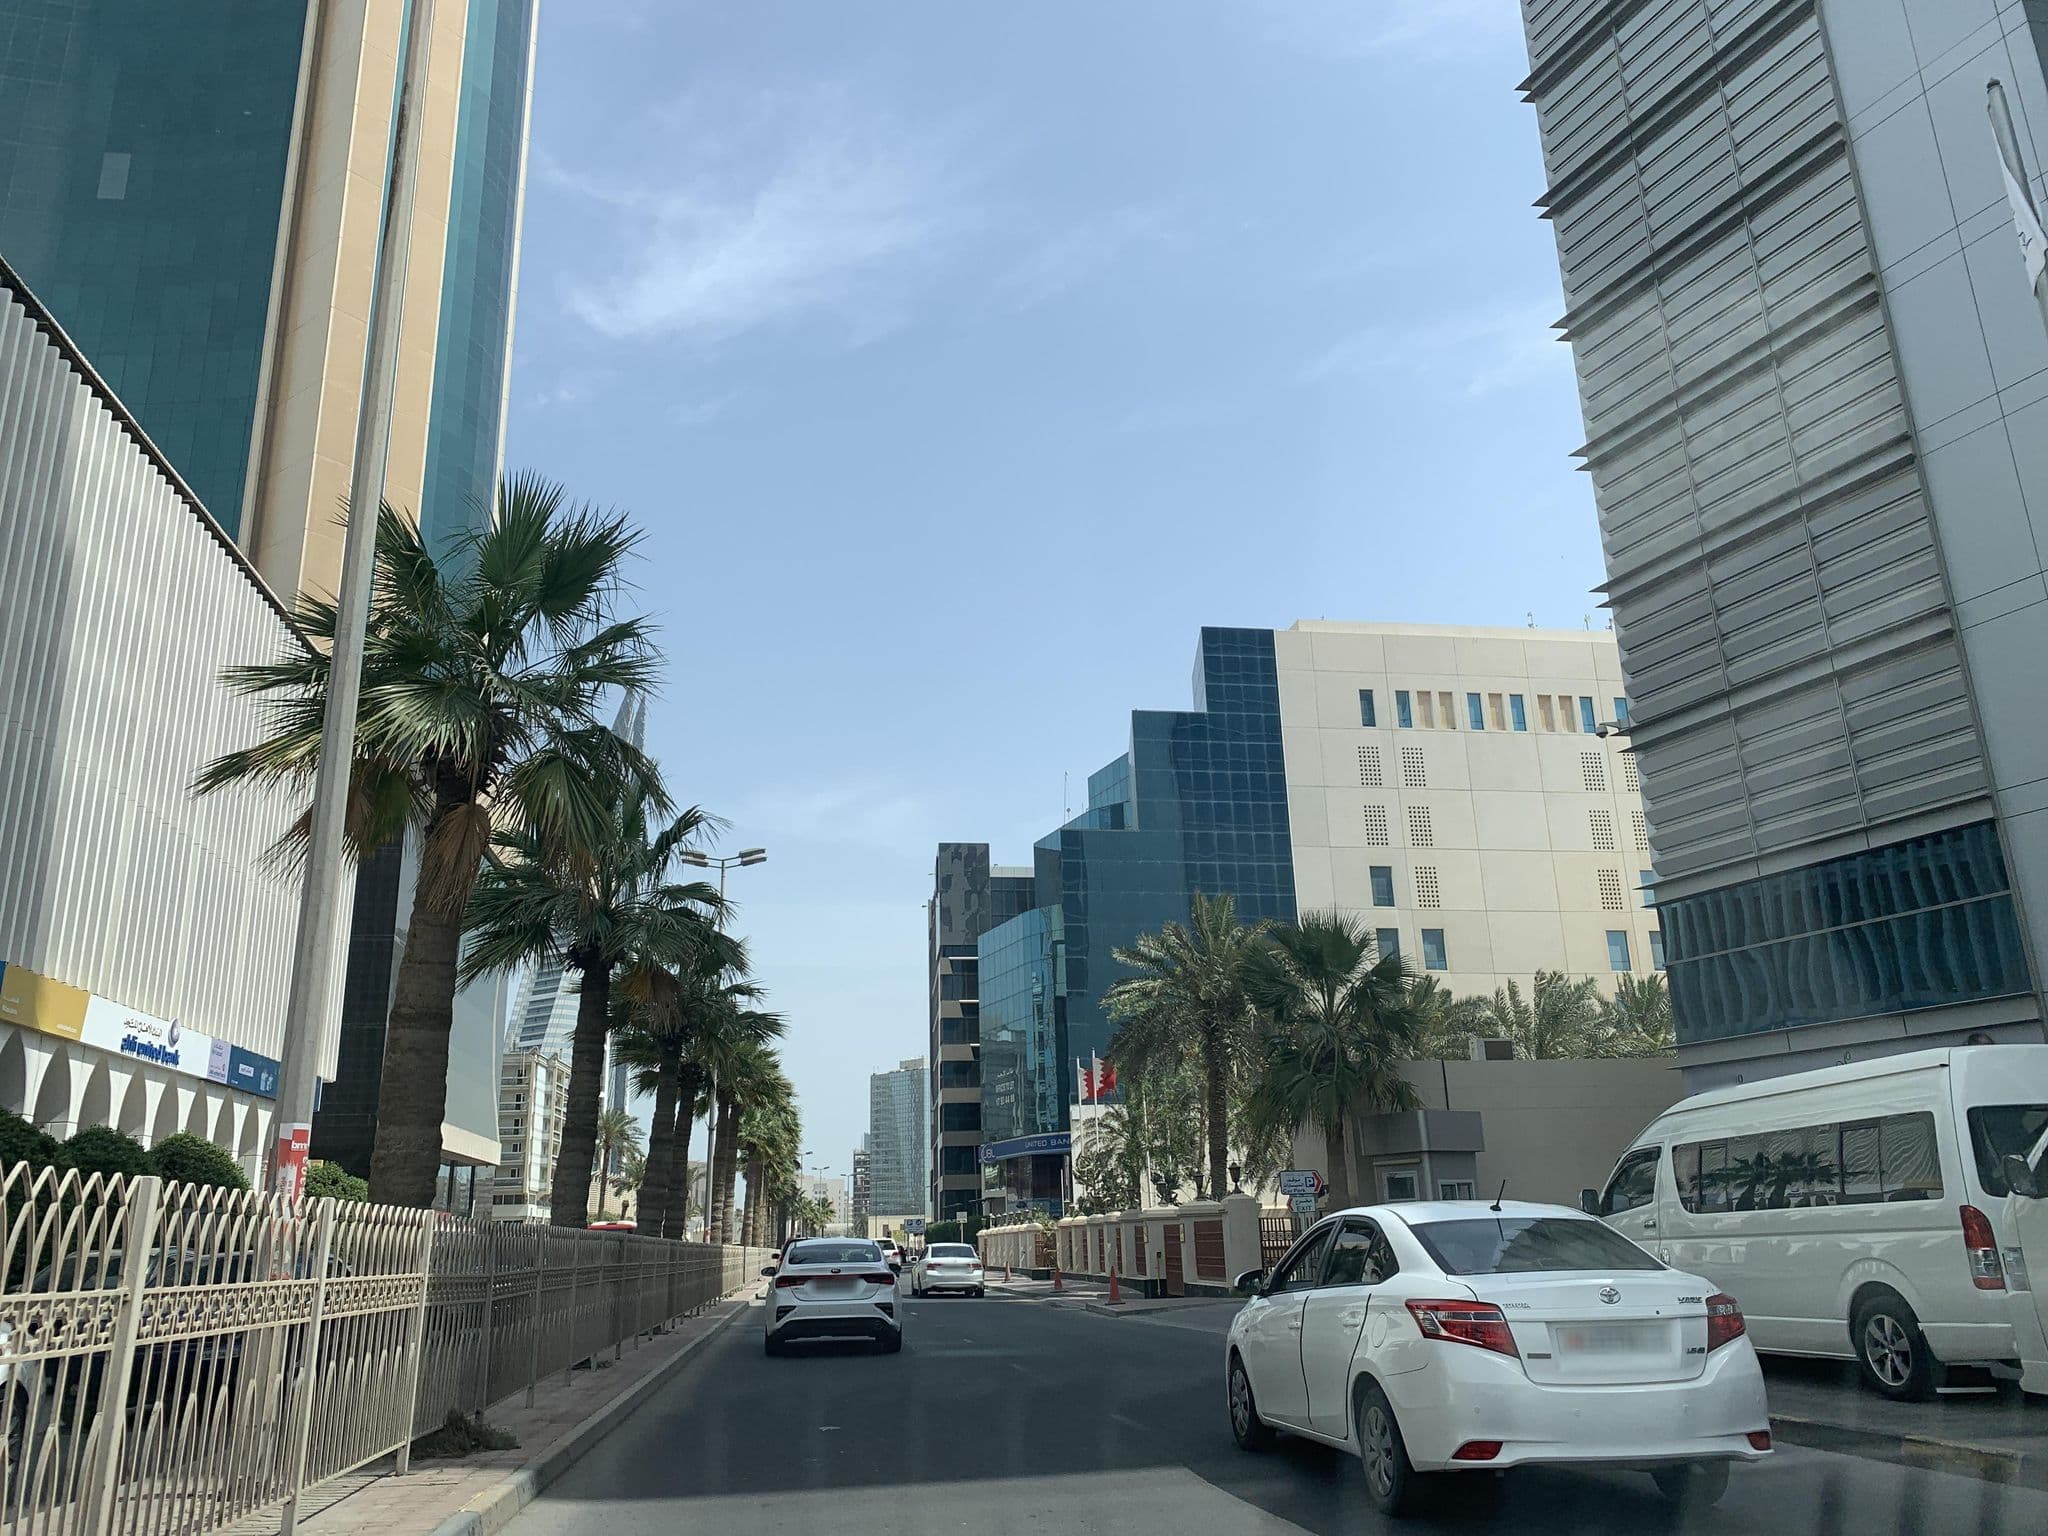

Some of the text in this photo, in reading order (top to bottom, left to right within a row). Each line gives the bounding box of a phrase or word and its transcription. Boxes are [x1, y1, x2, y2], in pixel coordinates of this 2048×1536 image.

[137, 1041, 162, 1062] united
[161, 1044, 180, 1067] bank
[1025, 1139, 1048, 1148] UNITED
[1050, 1137, 1070, 1146] BAN
